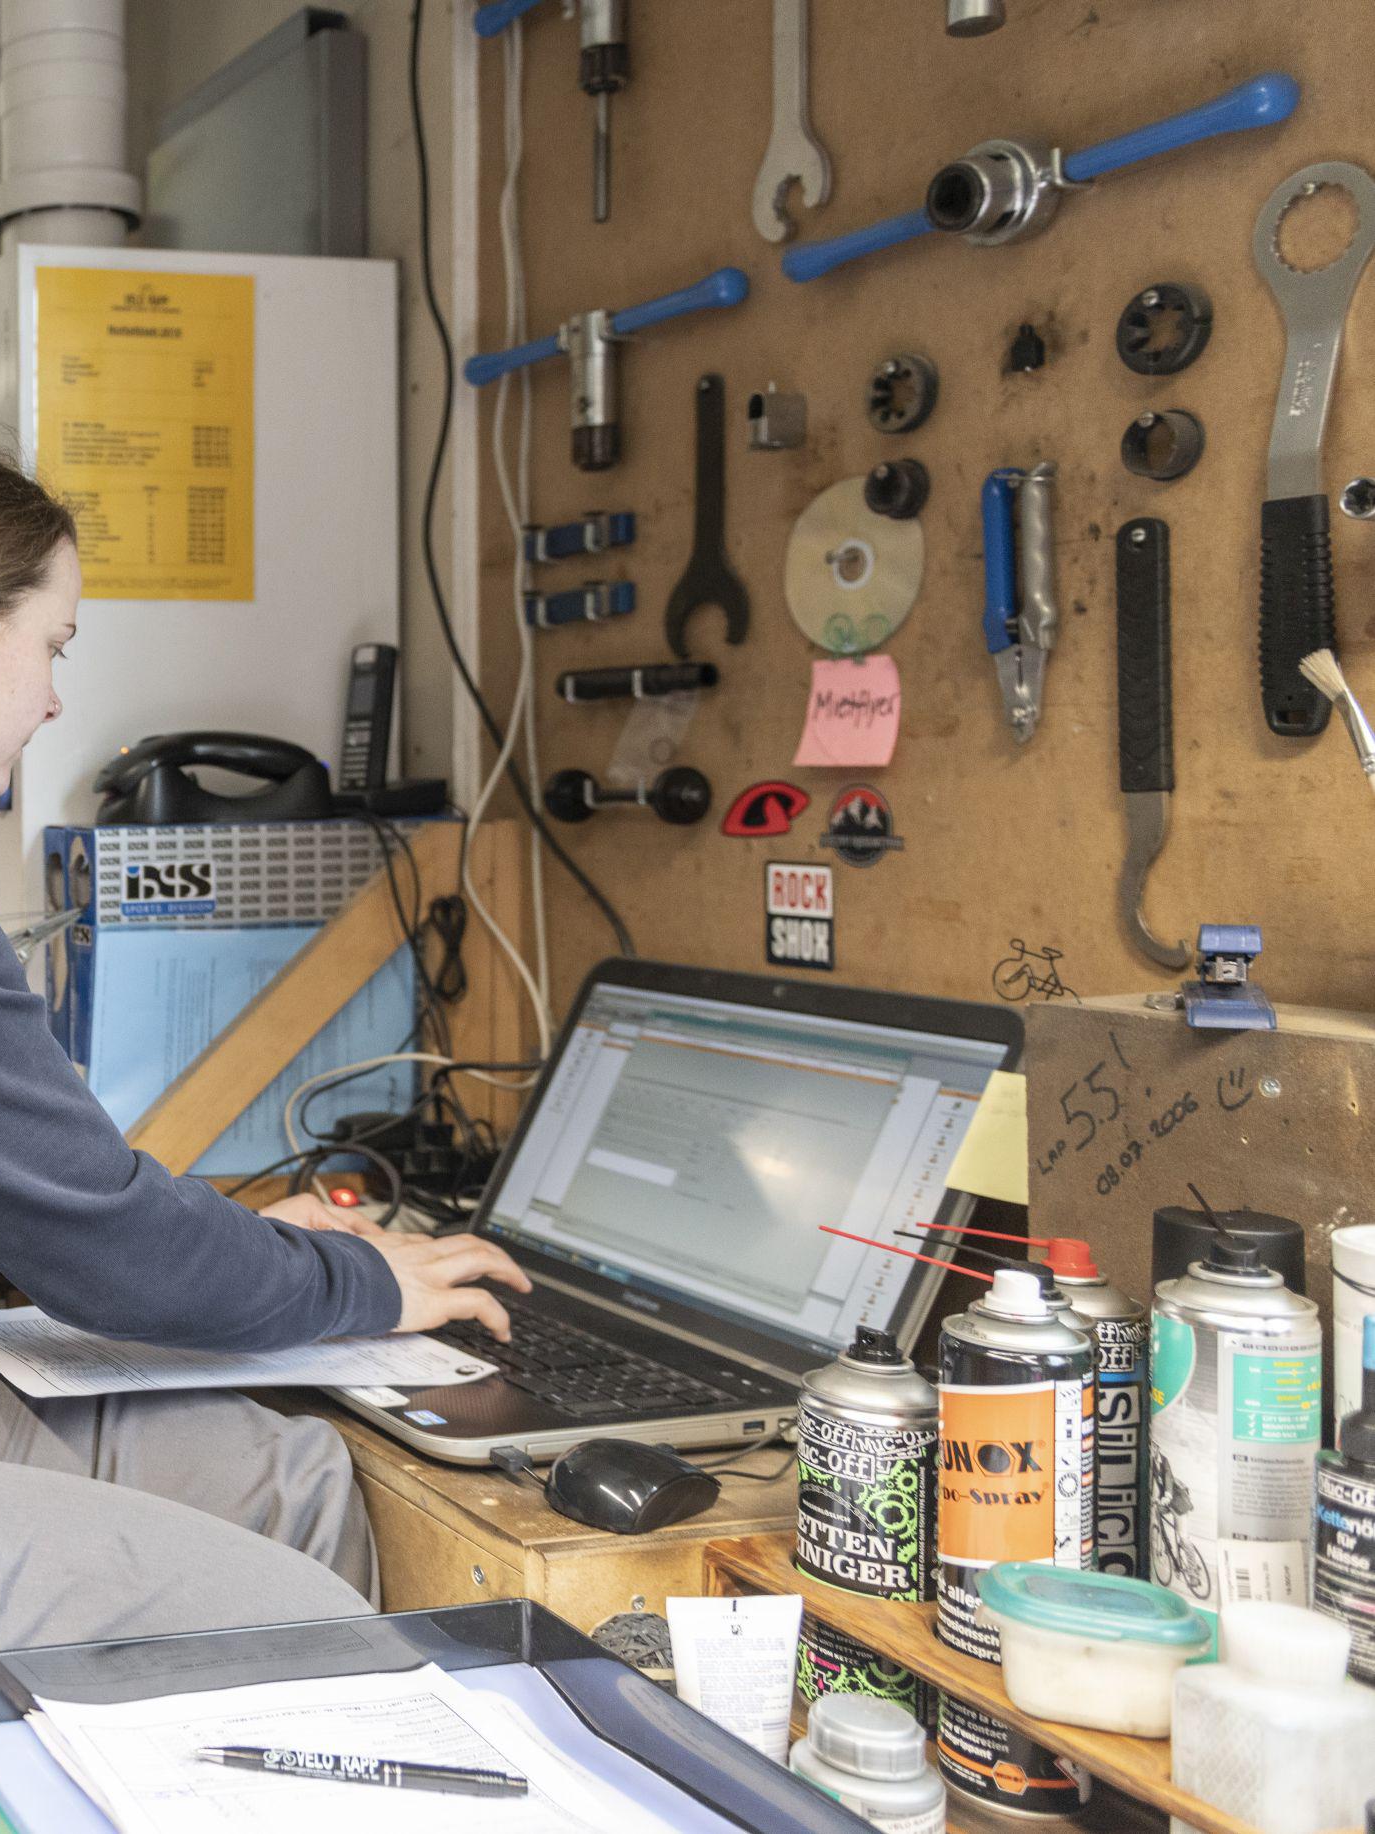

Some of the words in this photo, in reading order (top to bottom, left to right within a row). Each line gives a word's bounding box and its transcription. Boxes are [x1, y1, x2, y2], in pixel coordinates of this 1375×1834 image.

[774, 870, 826, 910] ROCK
[771, 917, 829, 962] SHOX
[797, 1507, 895, 1562] ETTEN
[296, 1750, 334, 1770] VELO
[340, 1754, 379, 1774] RAPP
